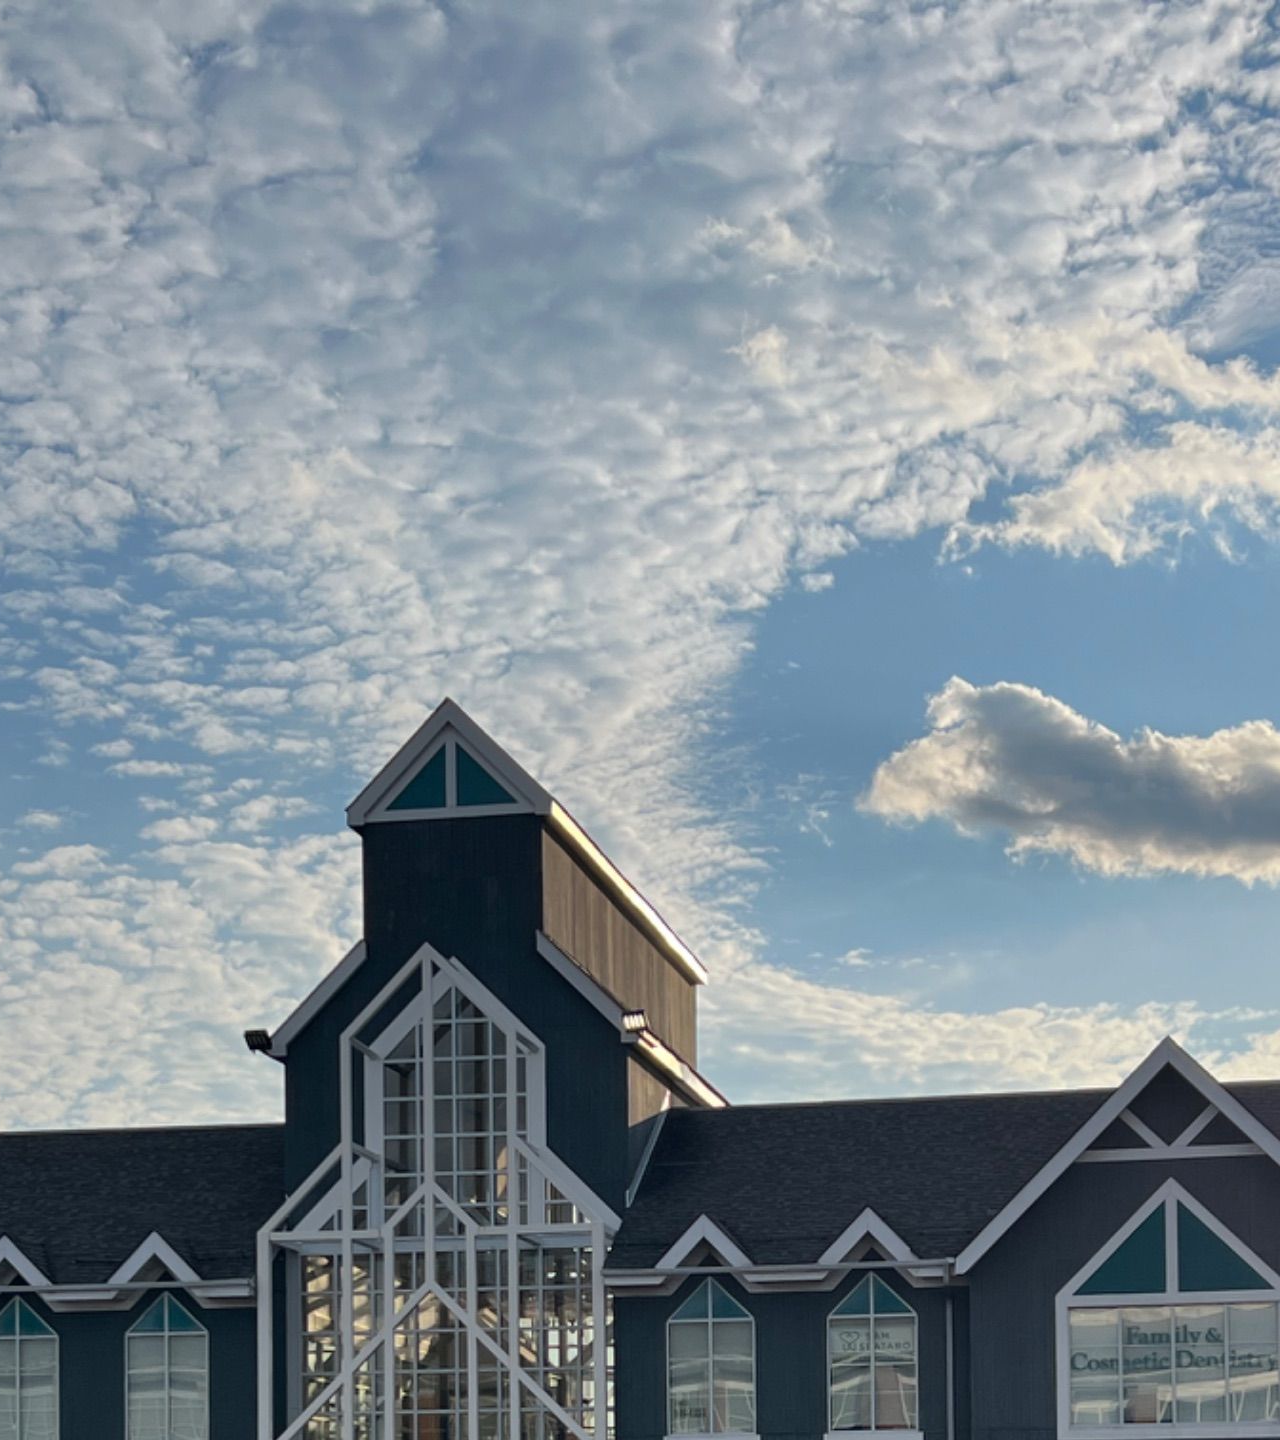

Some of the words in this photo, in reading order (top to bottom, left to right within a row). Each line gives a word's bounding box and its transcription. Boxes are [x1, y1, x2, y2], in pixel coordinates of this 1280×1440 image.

[1126, 1325, 1201, 1347] Family
[1205, 1327, 1224, 1344] &
[1070, 1351, 1170, 1371] Cosmetic
